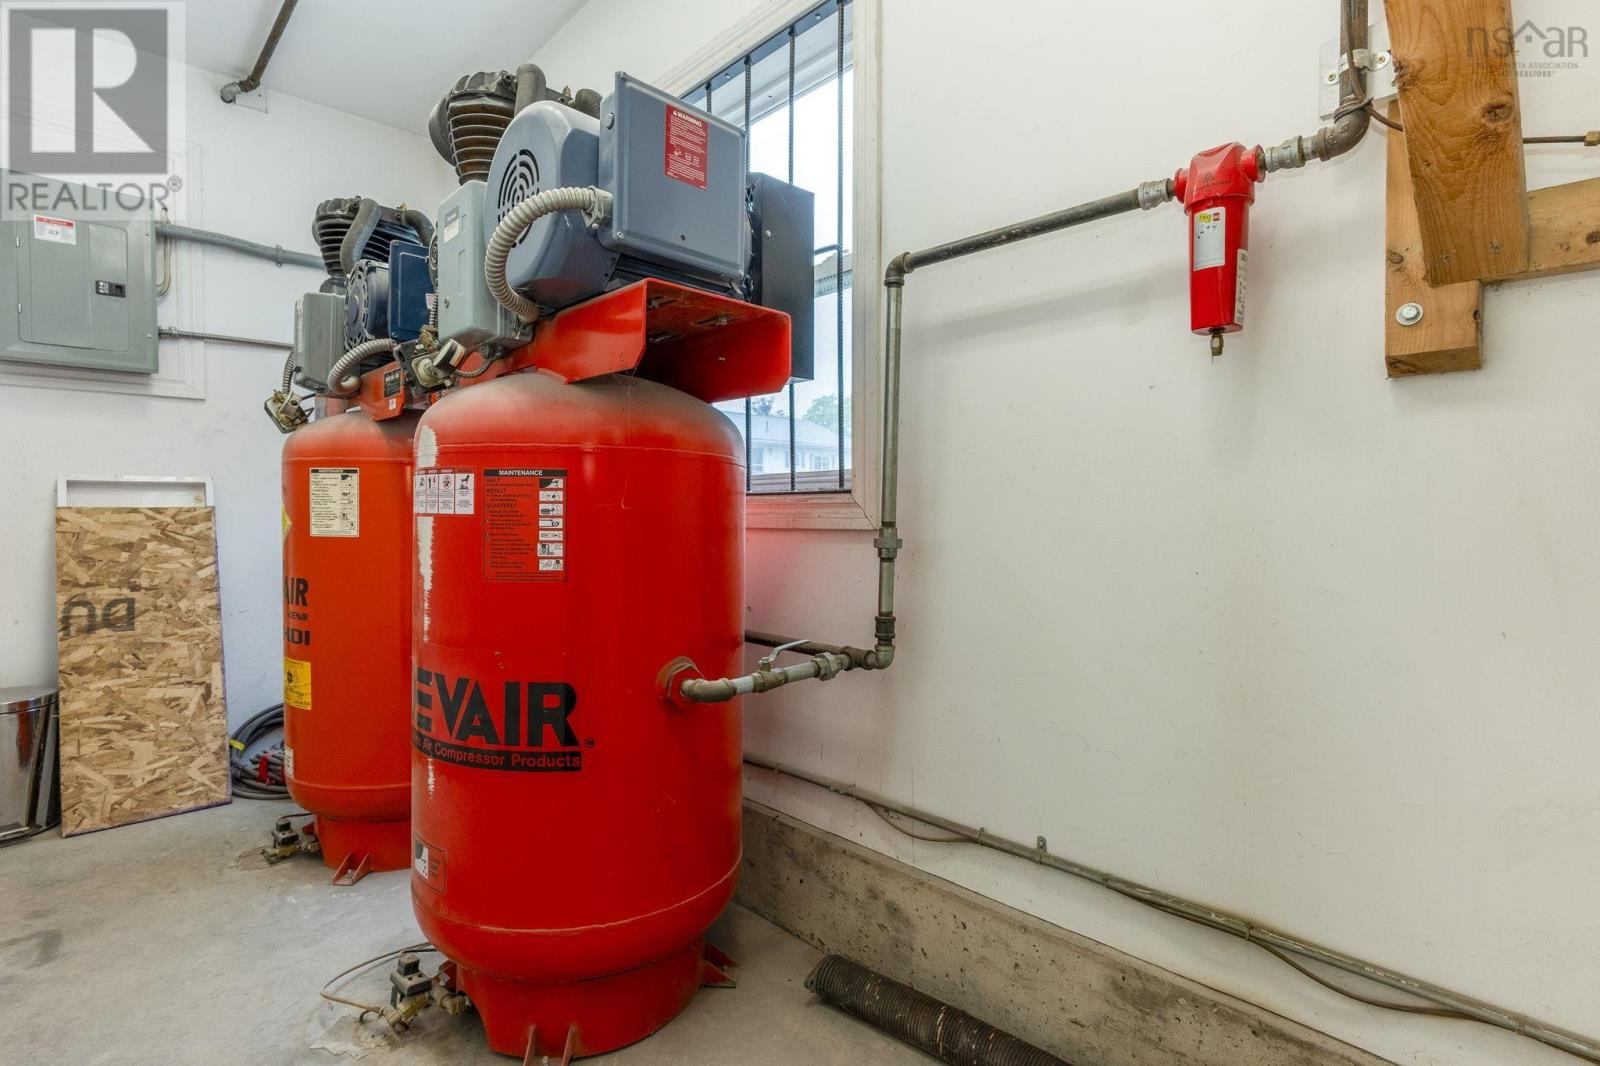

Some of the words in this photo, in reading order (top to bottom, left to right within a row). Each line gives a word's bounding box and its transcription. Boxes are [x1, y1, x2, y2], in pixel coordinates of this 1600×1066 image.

[676, 111, 703, 128] WARNING
[434, 742, 505, 766] Compressor
[511, 753, 581, 768] Products
